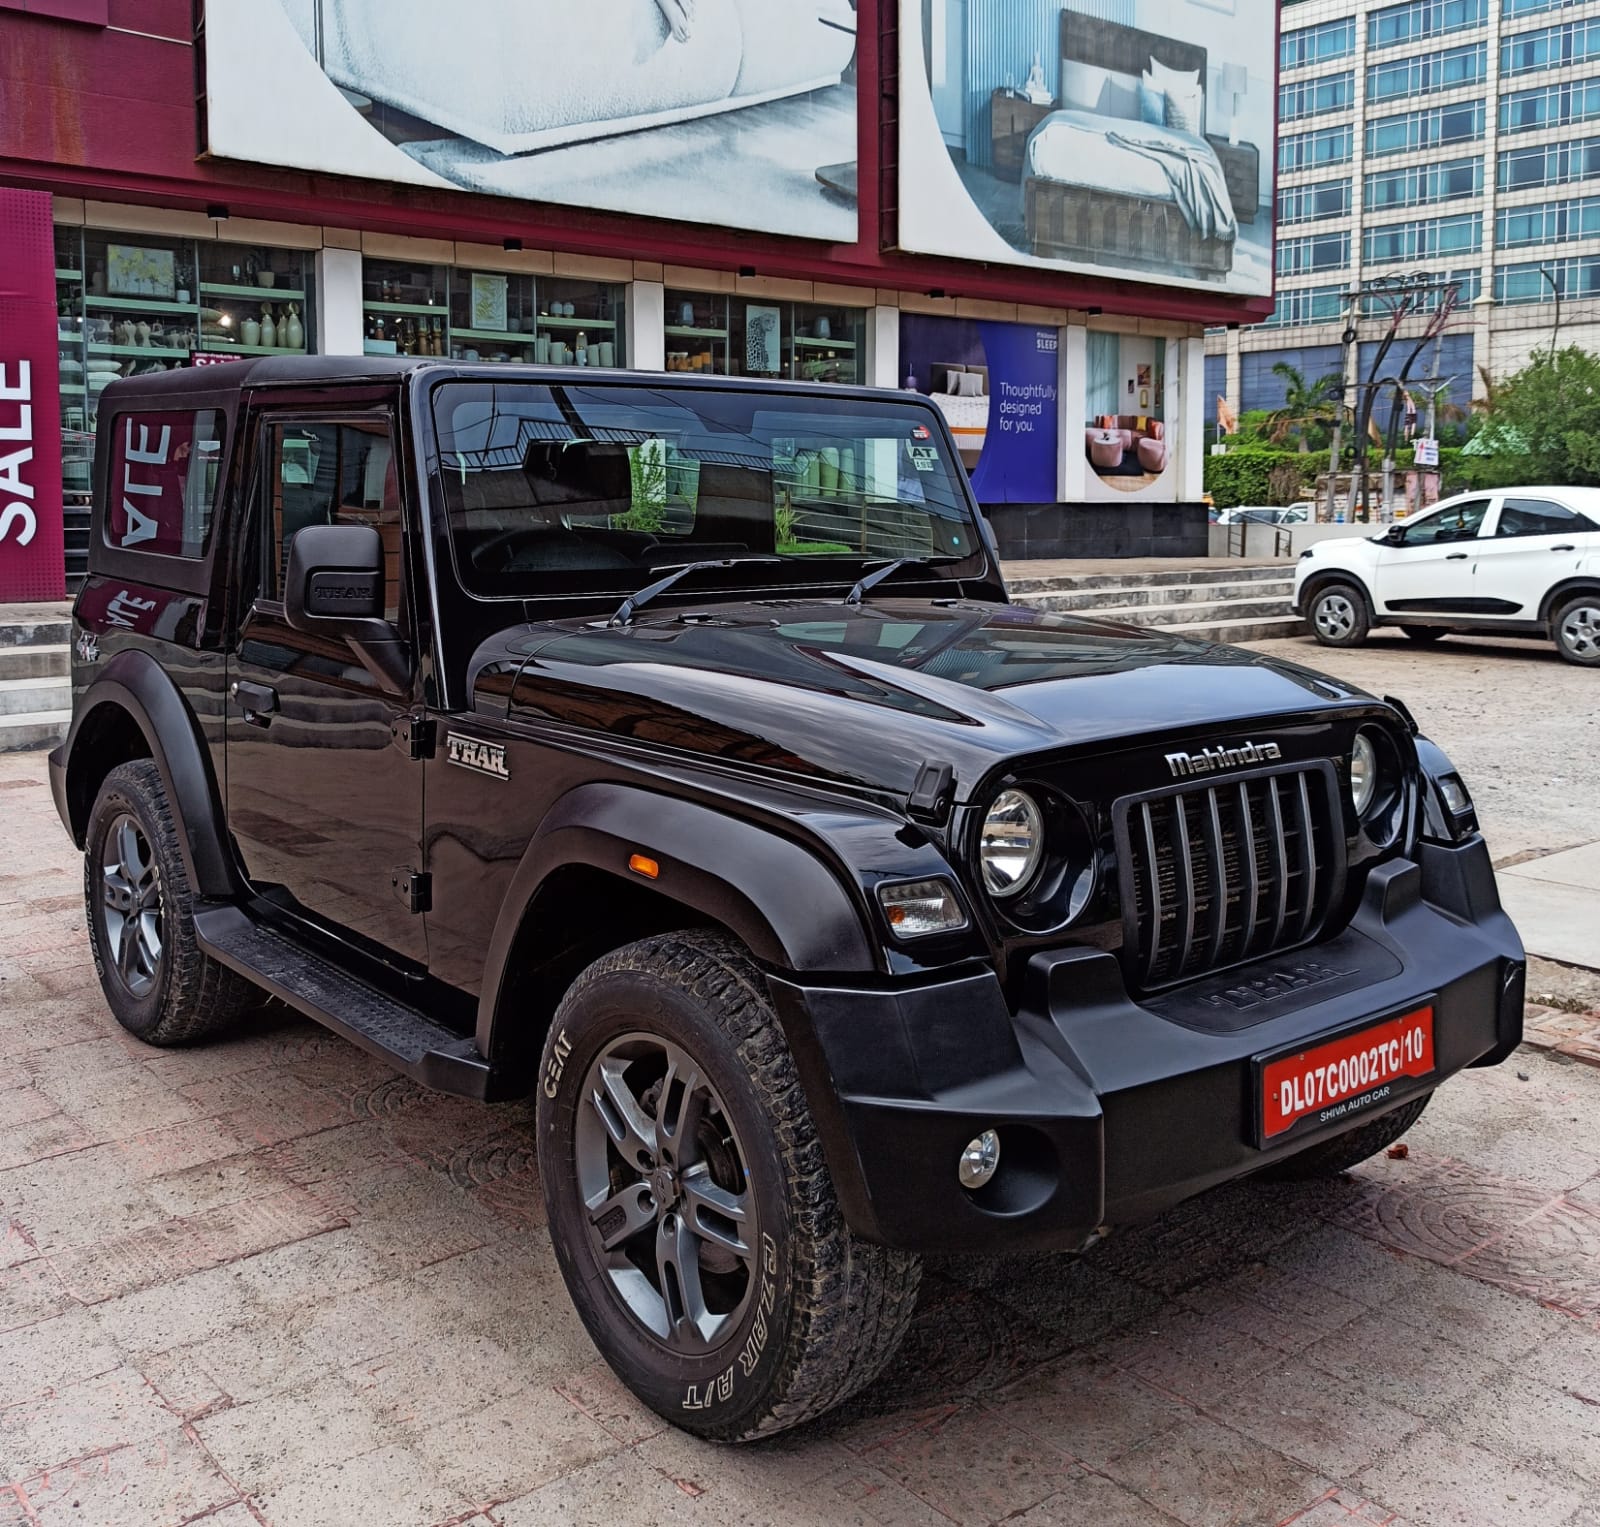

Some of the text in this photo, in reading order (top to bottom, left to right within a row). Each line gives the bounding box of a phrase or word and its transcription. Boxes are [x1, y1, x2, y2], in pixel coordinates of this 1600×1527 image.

[1036, 339, 1057, 350] SLEEP
[1000, 382, 1057, 401] Thoughtfully
[1000, 400, 1042, 417] designed
[1000, 417, 1035, 434] for you.
[0, 360, 37, 546] SALE
[912, 447, 932, 458] AT
[447, 734, 509, 777] THAR
[1164, 741, 1281, 776] Mahindra
[544, 1028, 572, 1098] CEAT
[1281, 1026, 1424, 1116] DL07C0002TC/10
[1319, 1086, 1390, 1122] SHIVA AUTO CAR
[682, 1232, 777, 1410] CZAR A/T
